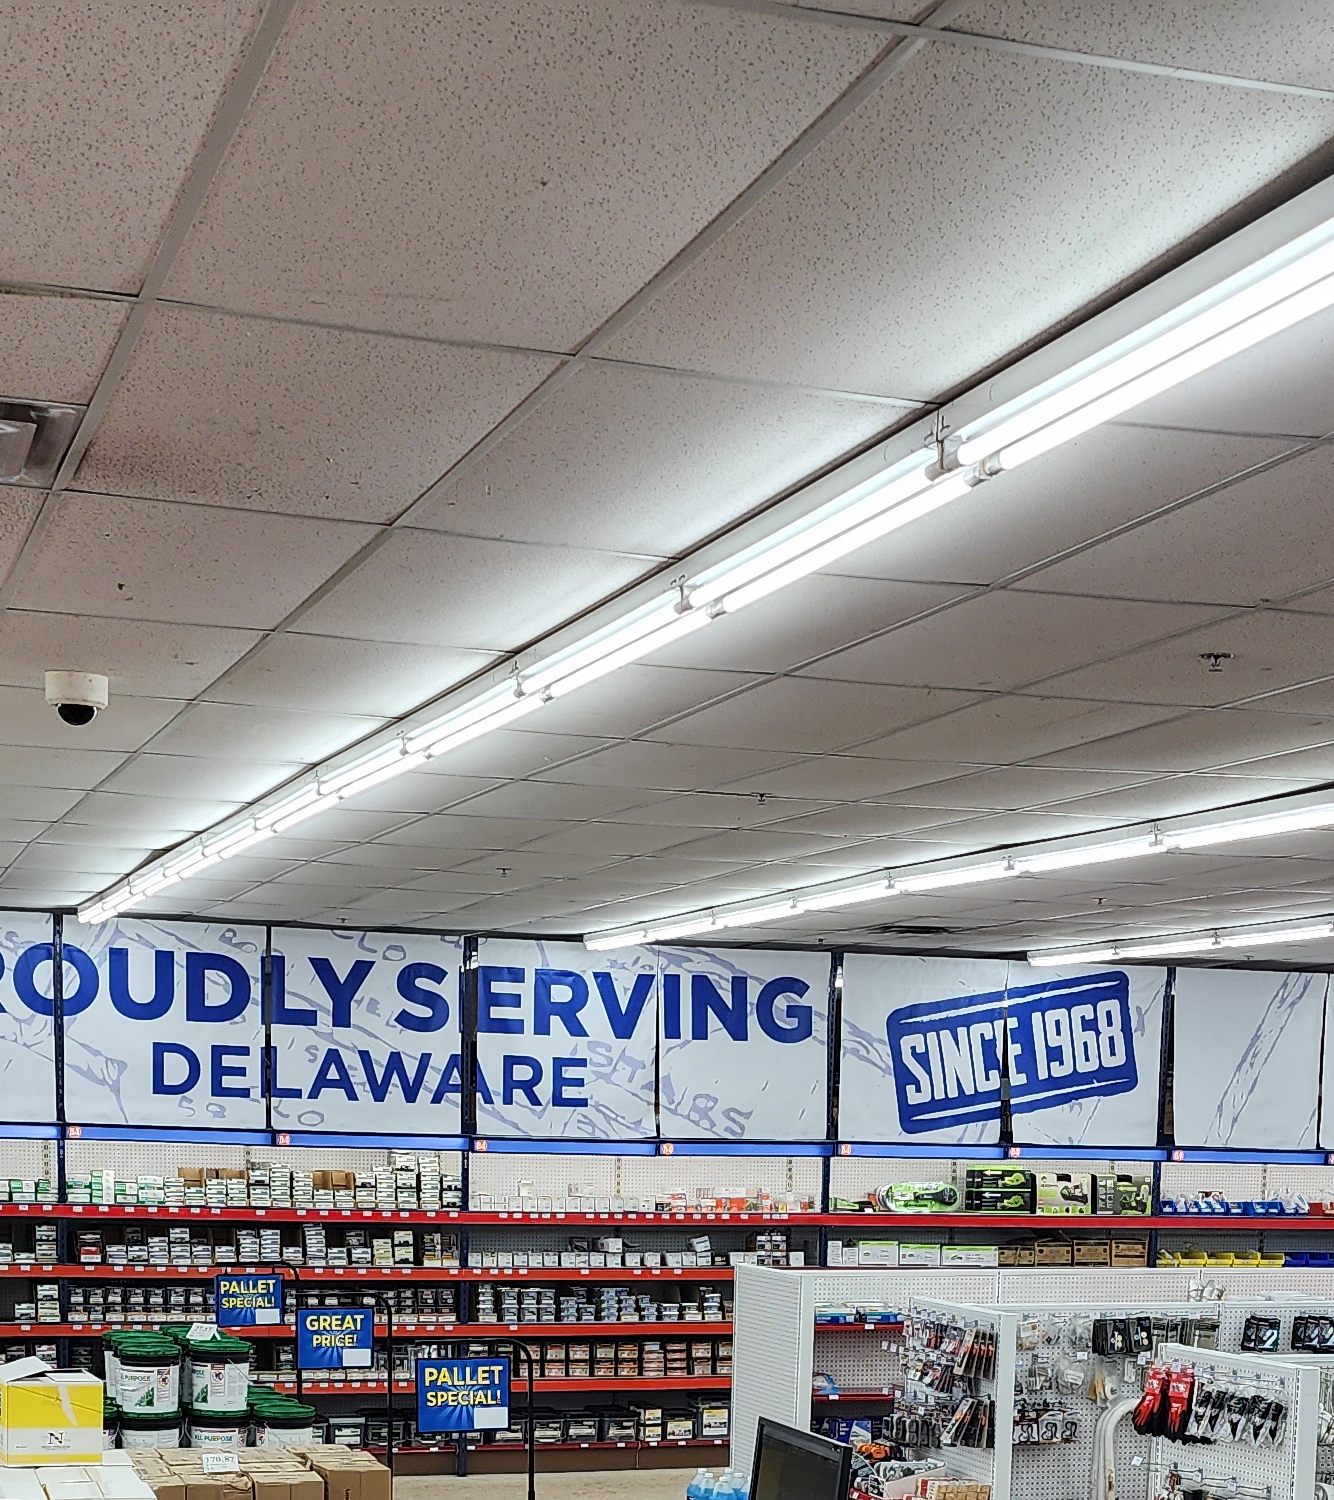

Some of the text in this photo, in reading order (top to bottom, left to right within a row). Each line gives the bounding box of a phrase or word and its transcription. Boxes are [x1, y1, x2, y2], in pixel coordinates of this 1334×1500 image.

[394, 961, 814, 1042] SERVING
[901, 1000, 1128, 1105] SINCE 1968
[151, 1041, 590, 1110] DELAWARE
[220, 1280, 277, 1295] PALLET
[221, 1294, 275, 1309] SPECIAL!
[305, 1314, 365, 1331] GREAT
[312, 1333, 358, 1348] PRICE!
[424, 1365, 504, 1387] PALLET
[426, 1389, 501, 1407] SPECIAL!
